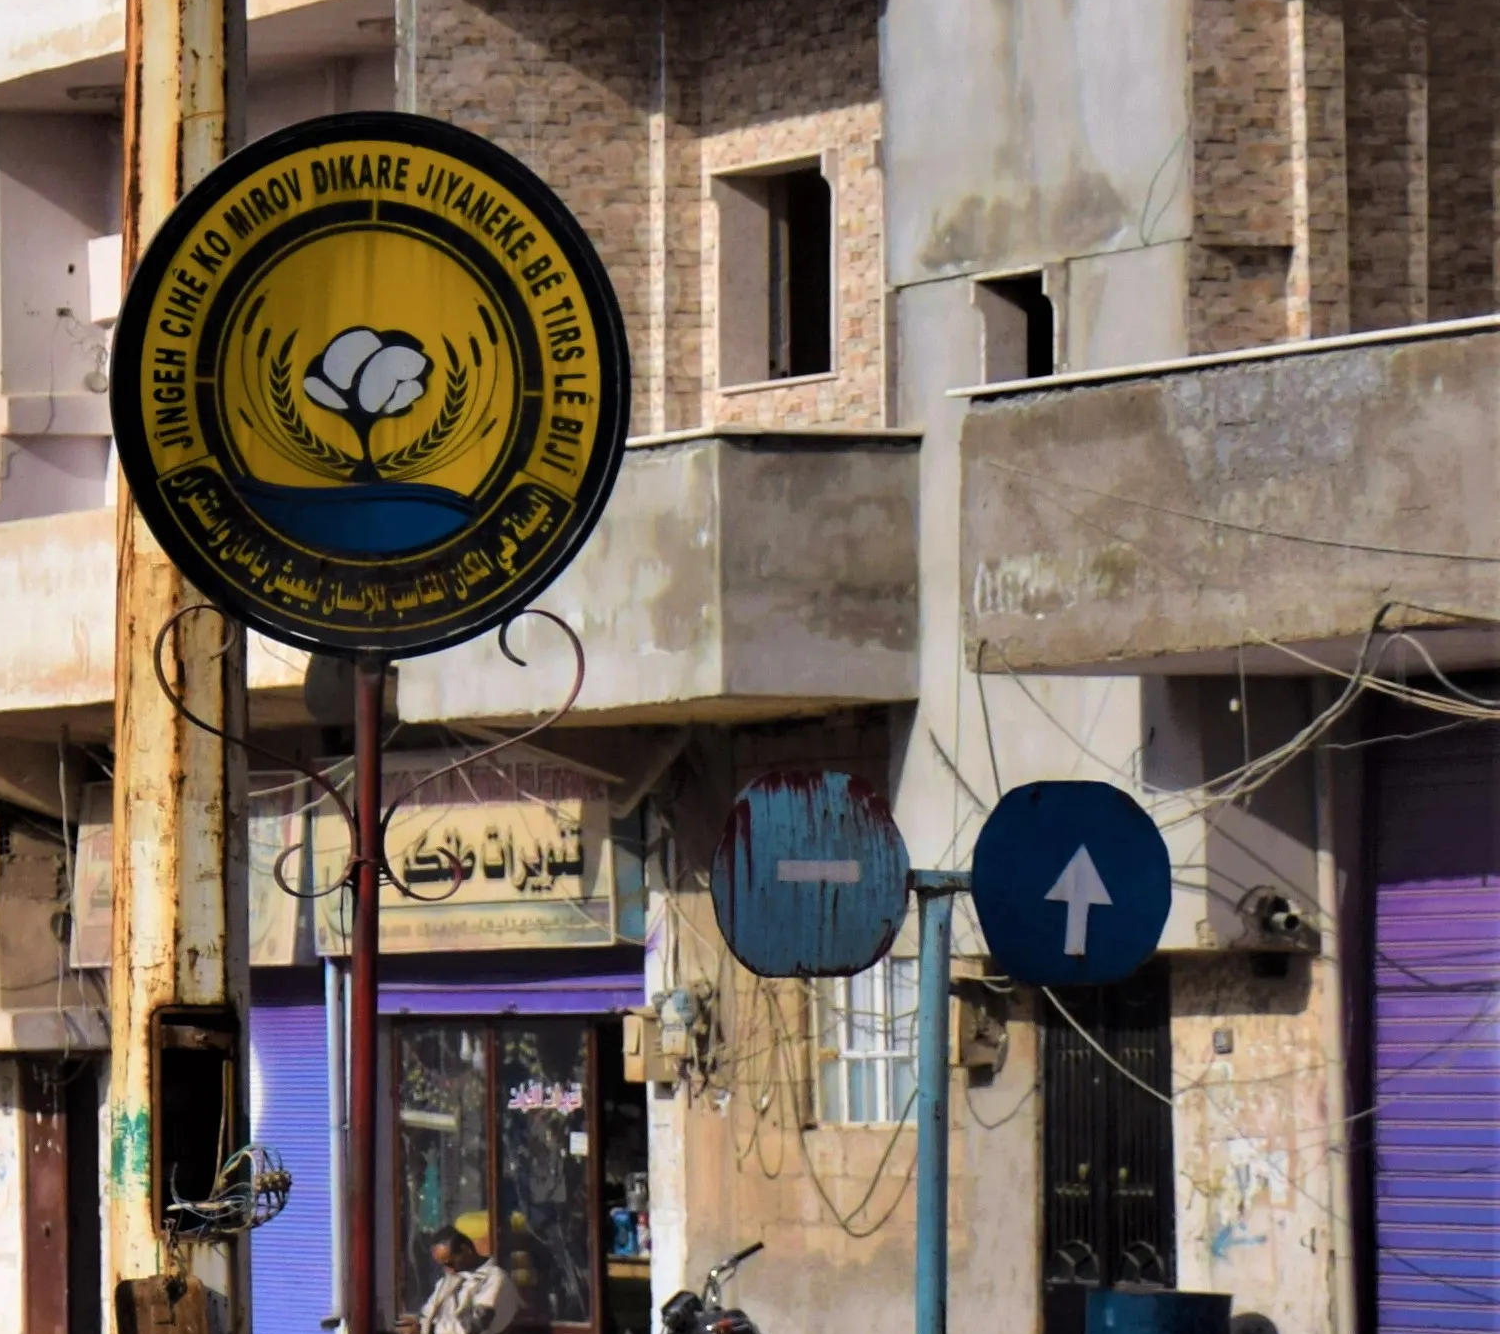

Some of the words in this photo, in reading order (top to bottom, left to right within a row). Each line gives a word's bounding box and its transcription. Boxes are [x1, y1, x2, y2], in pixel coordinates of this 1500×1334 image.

[311, 154, 409, 194] DIKARE
[222, 168, 303, 240] MIROV
[417, 163, 536, 265] JIYANEKE
[190, 230, 231, 274] KO
[522, 252, 570, 300] BÊ
[160, 268, 207, 338] CIHÊ
[543, 295, 586, 363] TIRS
[553, 369, 593, 408] LÊ
[540, 409, 585, 479] BIJÎ
[171, 476, 232, 548] واستقرار
[501, 488, 554, 540] البيئة
[450, 548, 495, 601] المكان
[496, 535, 518, 576] هي
[263, 558, 322, 611] ليعيش
